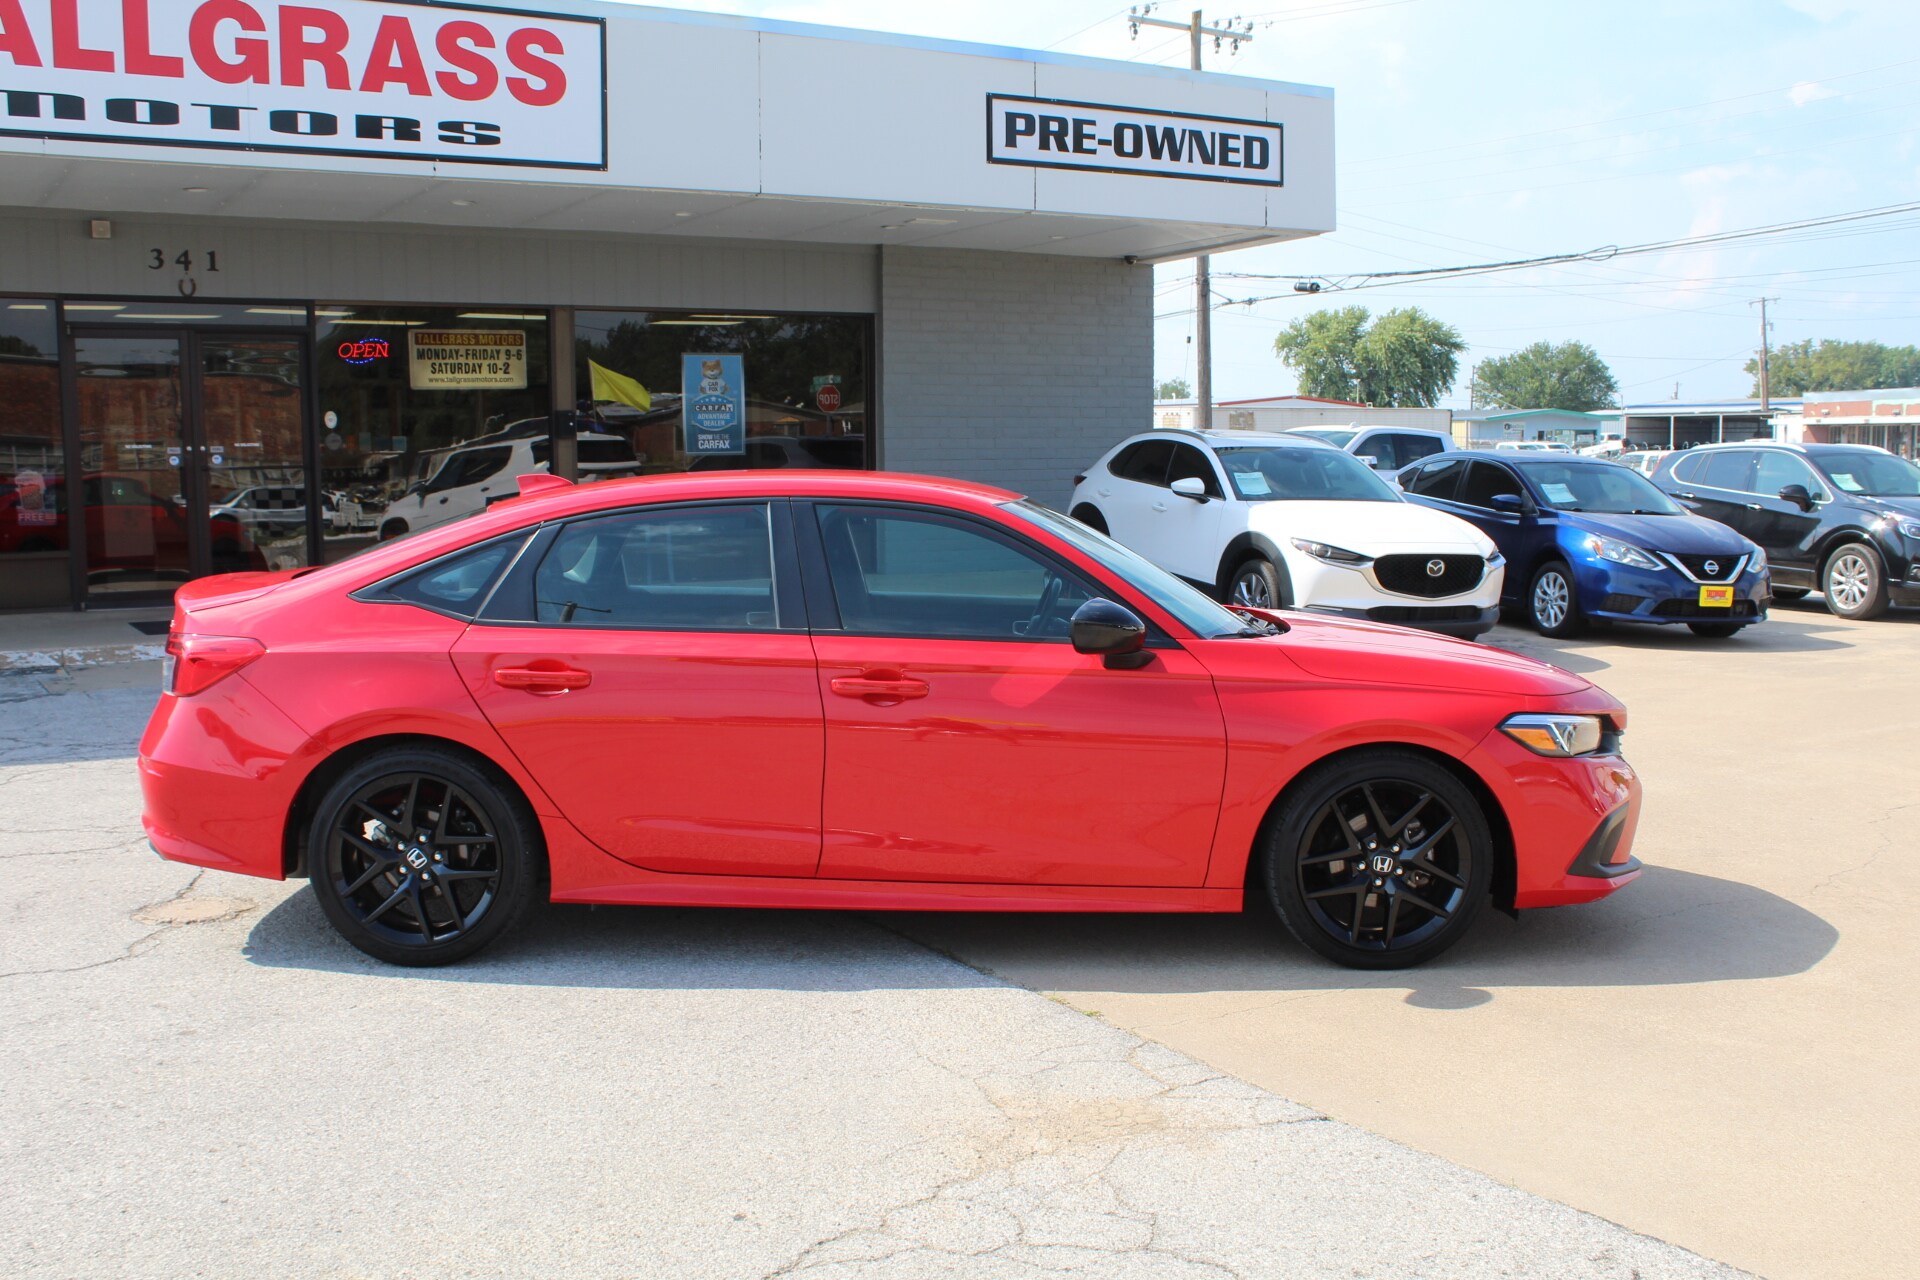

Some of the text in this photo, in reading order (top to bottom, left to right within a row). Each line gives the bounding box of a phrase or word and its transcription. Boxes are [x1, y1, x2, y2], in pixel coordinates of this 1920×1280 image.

[1004, 111, 1270, 170] PRE-OWNED
[416, 333, 522, 345] TALLGRASS MOTORS
[338, 342, 390, 358] OPEN
[416, 348, 523, 361] MONDAY-FRIDAY 9-6
[430, 362, 511, 374] SATURDAY 10-2
[698, 440, 731, 449] CARFAX
